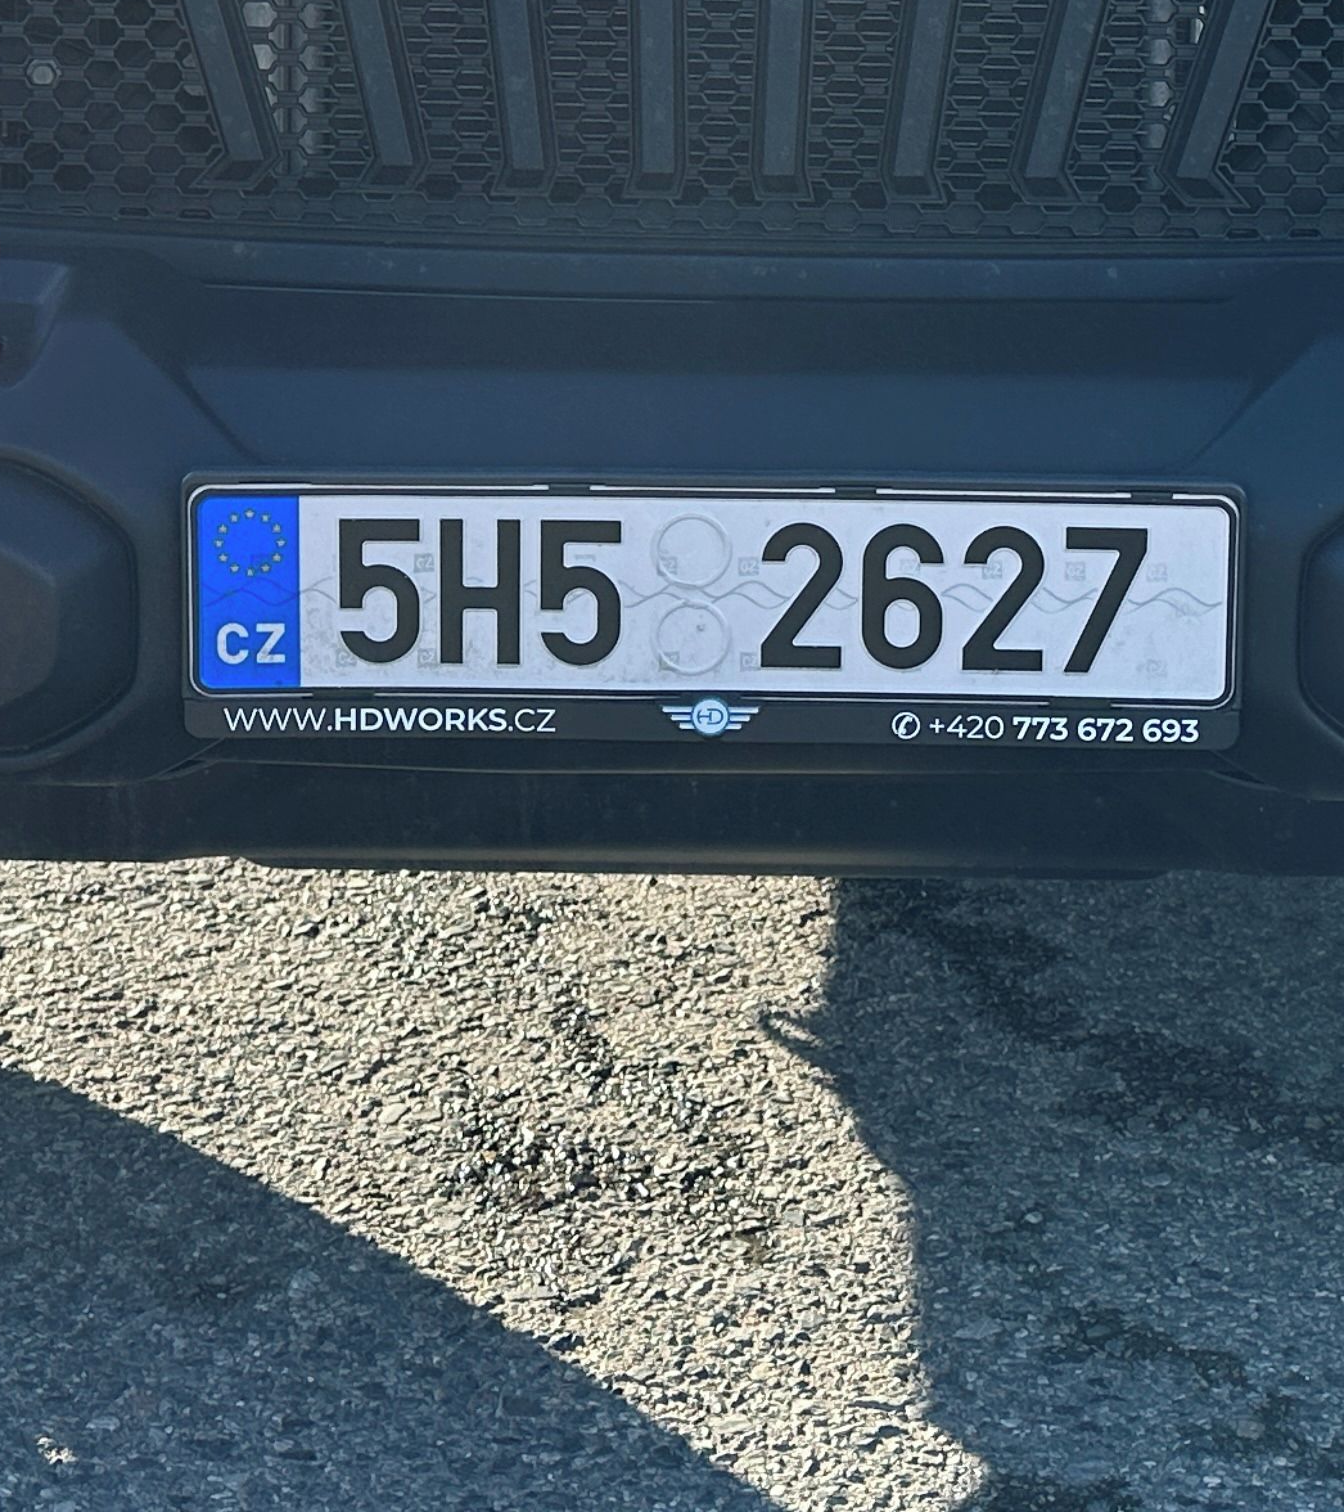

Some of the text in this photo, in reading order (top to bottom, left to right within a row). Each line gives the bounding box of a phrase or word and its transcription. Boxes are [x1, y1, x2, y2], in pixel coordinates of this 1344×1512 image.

[338, 518, 1149, 674] 5H5 2627
[216, 622, 286, 665] CZ
[223, 707, 557, 734] WWW.HDWORKS.CZ
[929, 714, 1199, 744] +420 773 672 693
